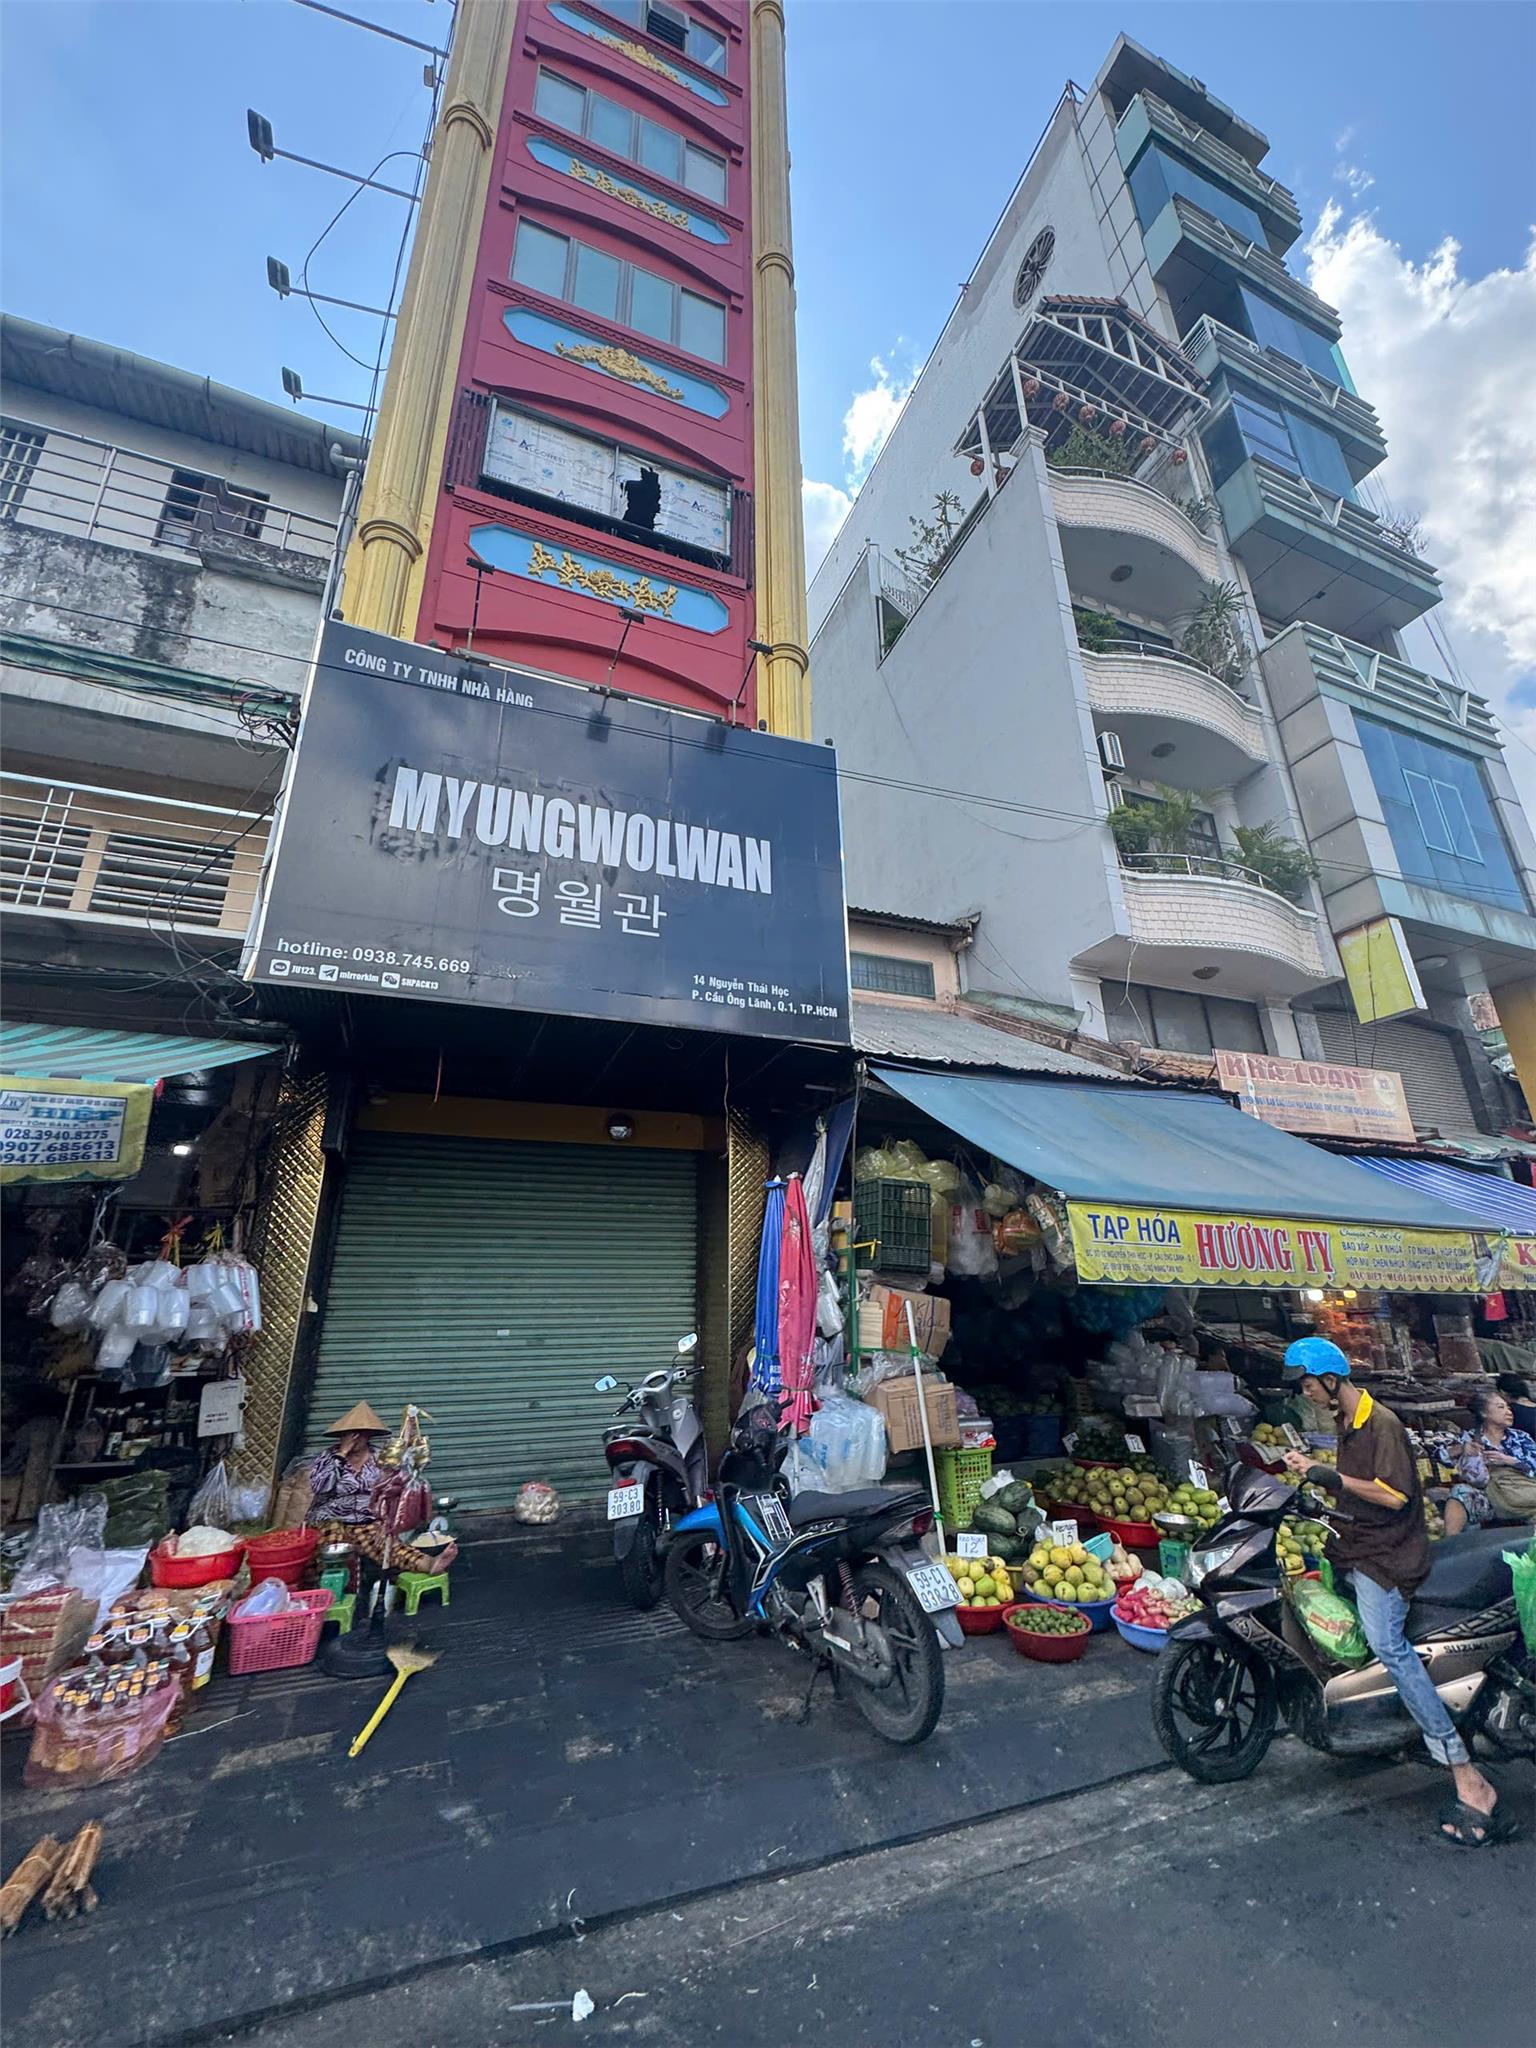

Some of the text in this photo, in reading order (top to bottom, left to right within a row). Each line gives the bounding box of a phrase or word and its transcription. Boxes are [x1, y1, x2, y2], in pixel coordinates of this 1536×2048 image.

[344, 648, 534, 709] CÔNG TY TNHH NHÀ HÀNG
[388, 766, 773, 895] MYUNGWOLWAN
[277, 938, 471, 974] hotline: 0938.745.669
[339, 971, 379, 983] mirrorkim
[693, 974, 705, 985] 14
[747, 981, 768, 994] Thái
[771, 984, 790, 999] Học
[692, 989, 703, 1000] P.
[727, 992, 746, 1009] Ông
[800, 1003, 838, 1018] TP.HCM
[4, 1128, 109, 1140] 028.3940.8275
[0, 1150, 114, 1163] 947.685613
[1136, 1212, 1181, 1244] HÓA
[1194, 1220, 1293, 1272] HƯƠNG
[613, 1487, 639, 1504] 59-C3
[610, 1500, 641, 1517] 303.80
[964, 1541, 979, 1554] 12
[913, 1567, 946, 1589] 59-C1
